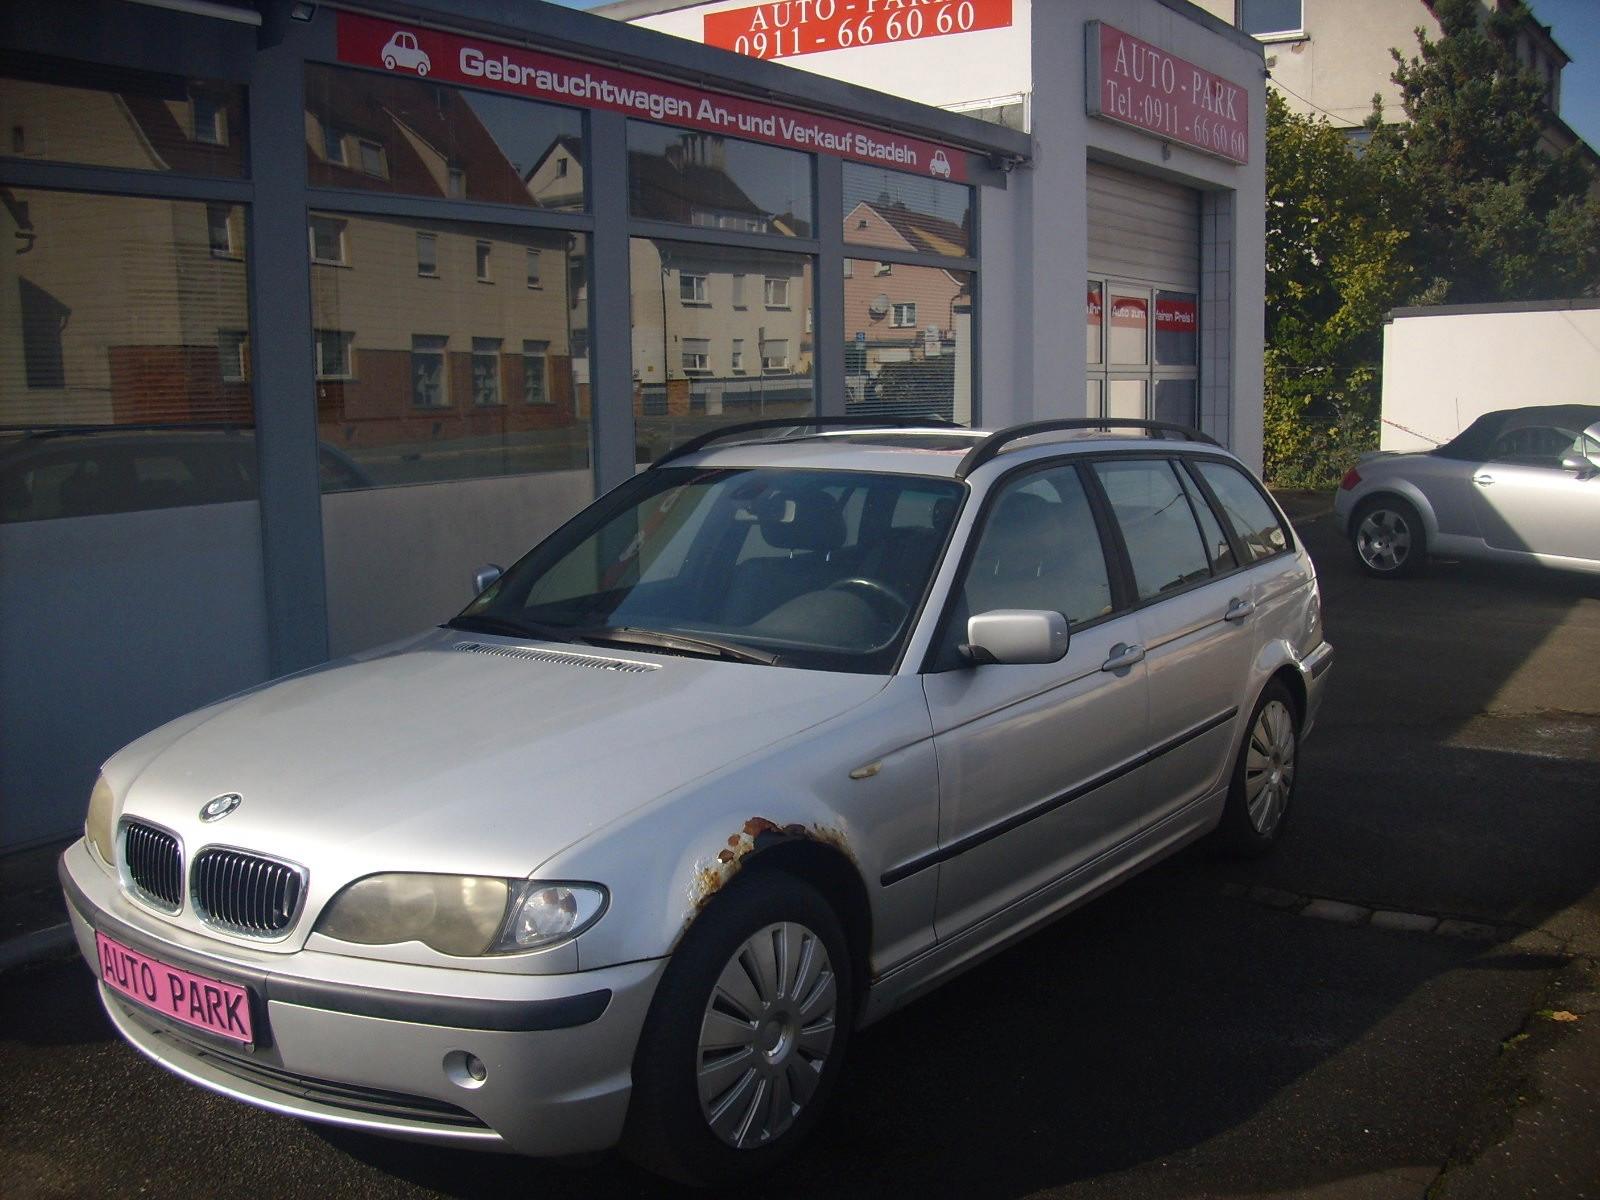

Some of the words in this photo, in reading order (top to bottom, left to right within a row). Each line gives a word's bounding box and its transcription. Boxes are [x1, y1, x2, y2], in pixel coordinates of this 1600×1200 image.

[735, 27, 800, 59] 0911
[838, 16, 873, 47] 66
[886, 9, 923, 40] 60
[936, 2, 974, 33] 60
[750, 0, 835, 31] AUTO
[459, 47, 692, 119] Gebrauchtwagen
[779, 117, 853, 152] Verkauf
[855, 134, 917, 165] Stadeln
[1114, 37, 1175, 95] AUTO
[1192, 71, 1237, 122] PARK
[1194, 114, 1209, 146] 66
[103, 942, 157, 1002] AUTO
[167, 972, 248, 1036] PARK
